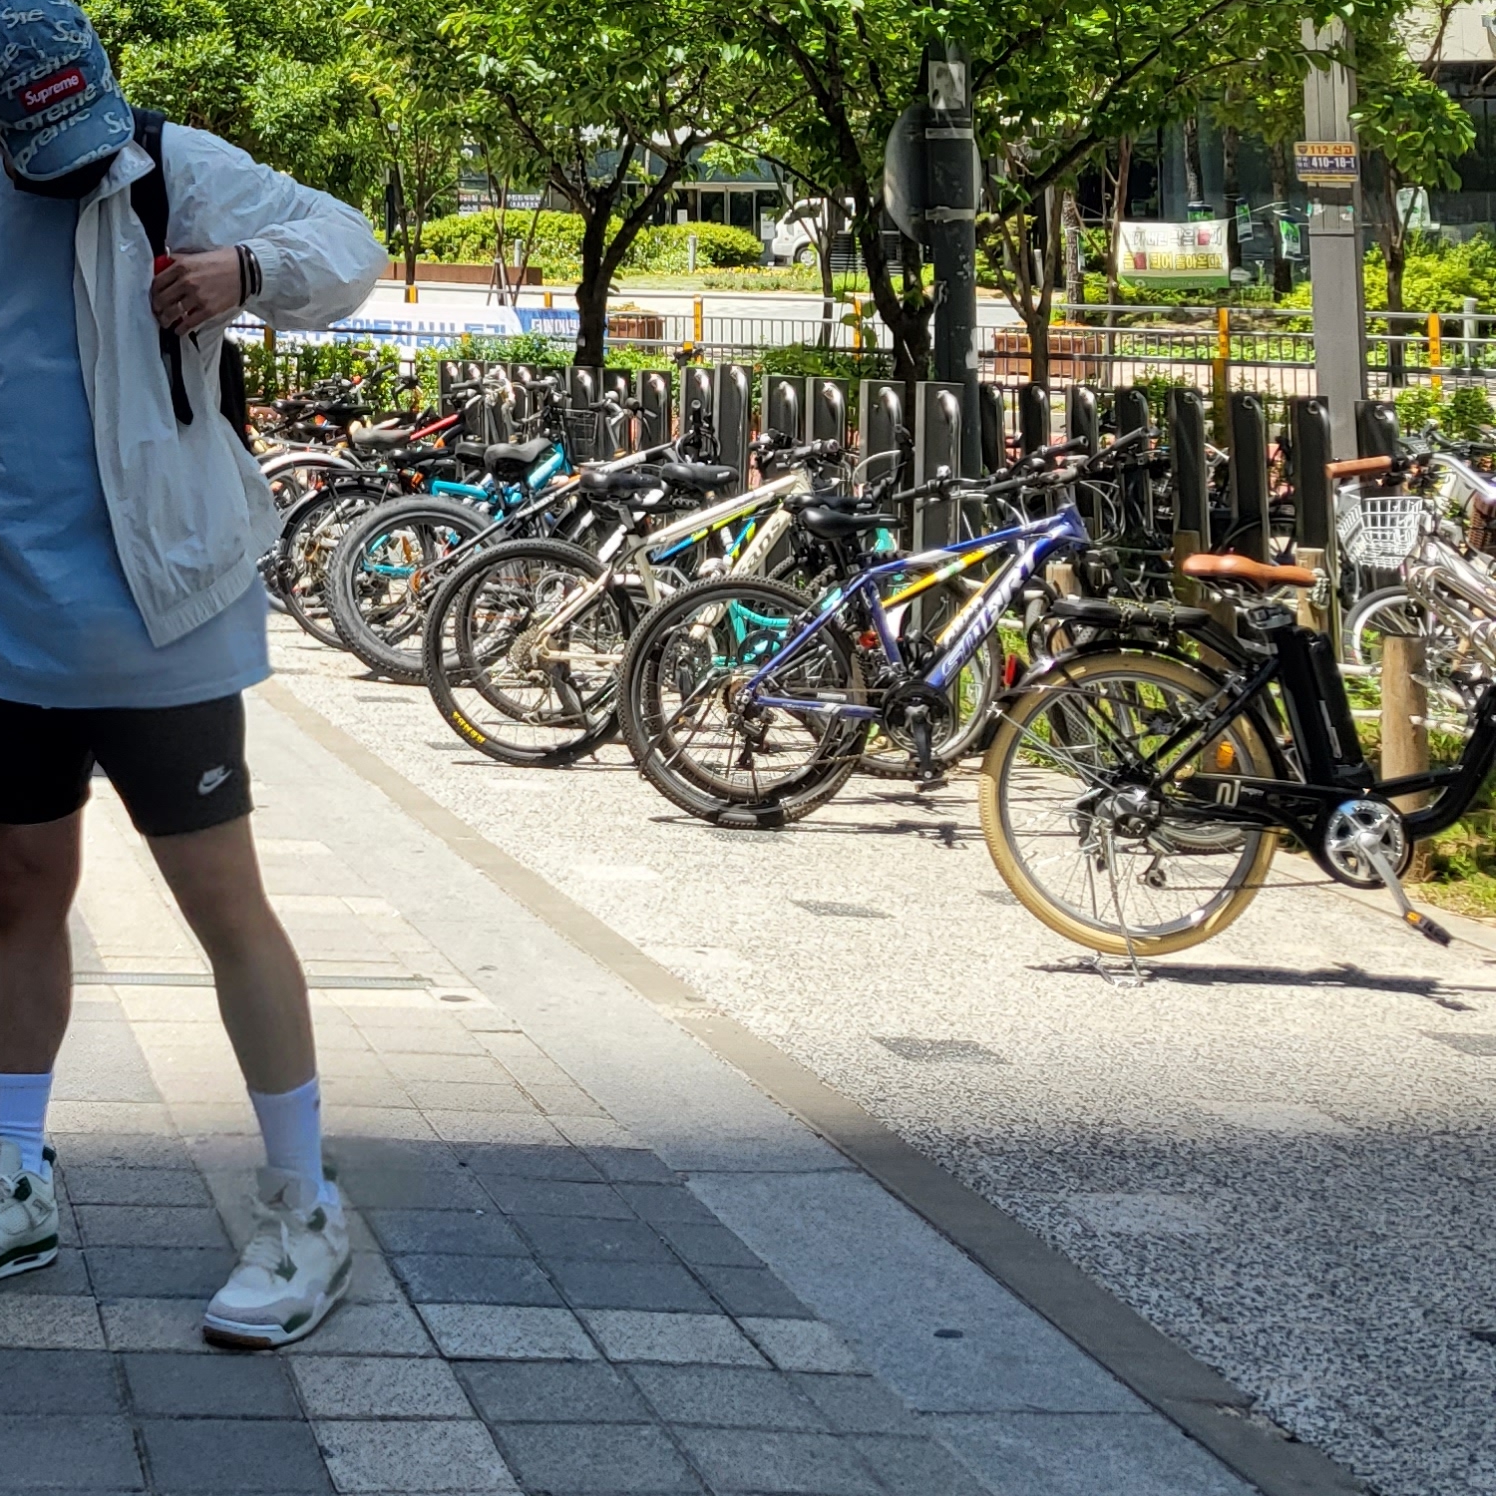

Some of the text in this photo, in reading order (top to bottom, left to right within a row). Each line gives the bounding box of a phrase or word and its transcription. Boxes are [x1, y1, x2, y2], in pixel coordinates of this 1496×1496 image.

[25, 75, 80, 106] Supreme
[1310, 145, 1353, 155] 112 신고
